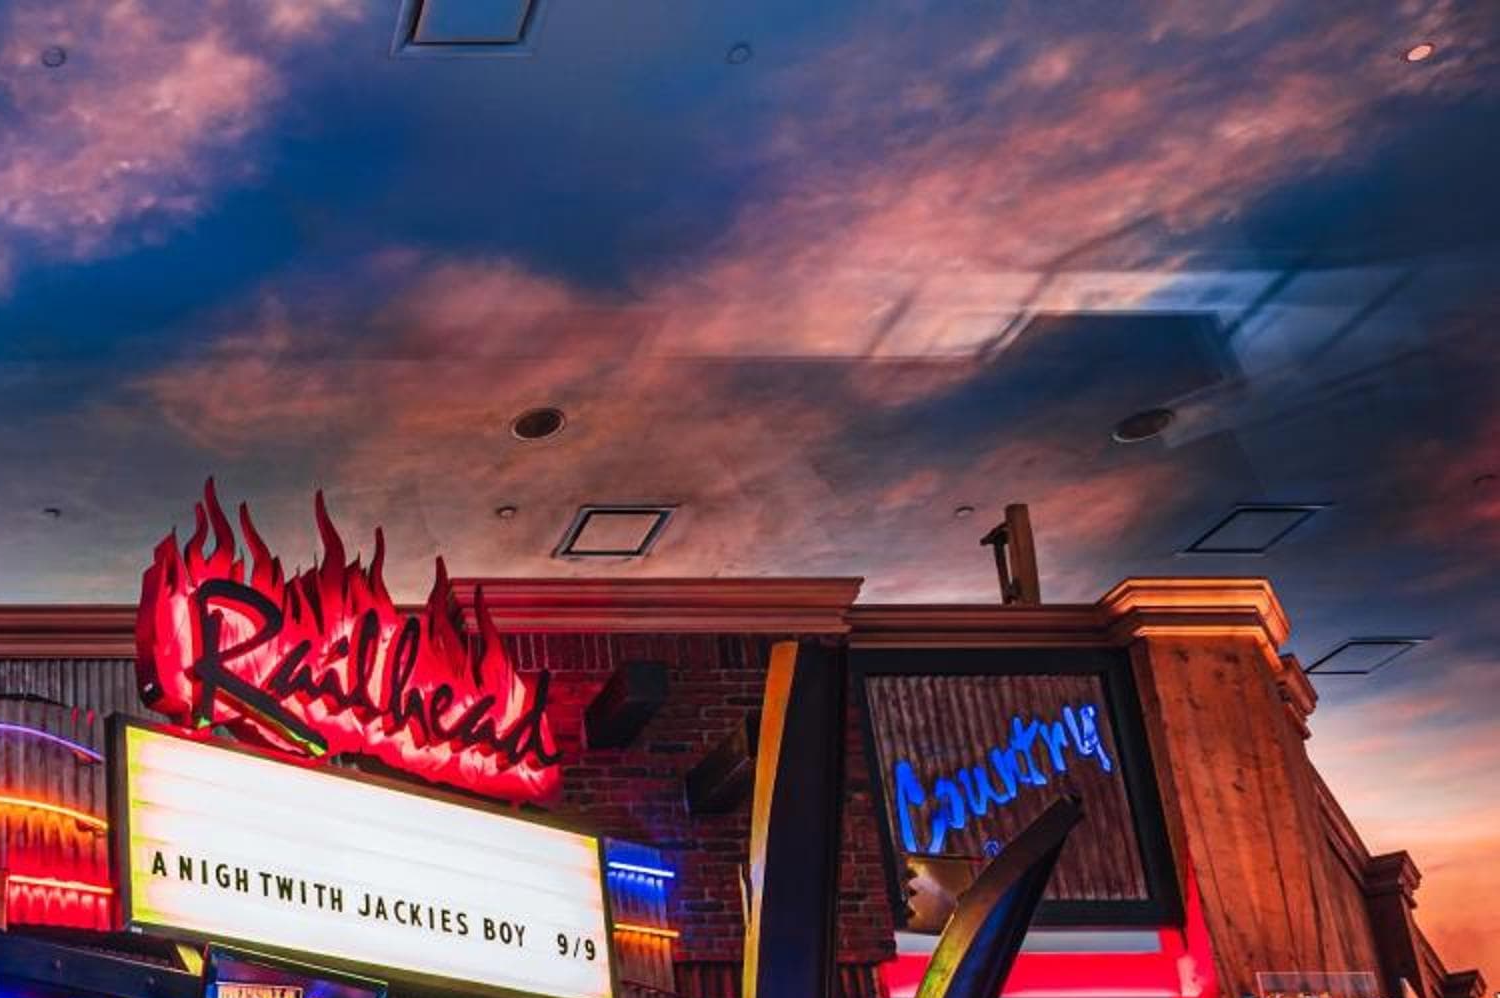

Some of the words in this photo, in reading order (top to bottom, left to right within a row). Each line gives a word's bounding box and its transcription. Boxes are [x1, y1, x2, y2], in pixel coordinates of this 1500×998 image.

[186, 577, 564, 767] Railhead
[893, 703, 1113, 855] Country
[151, 850, 168, 878] A
[356, 892, 470, 937] JACKIES
[483, 918, 528, 948] BOY
[556, 932, 597, 961] 9/9
